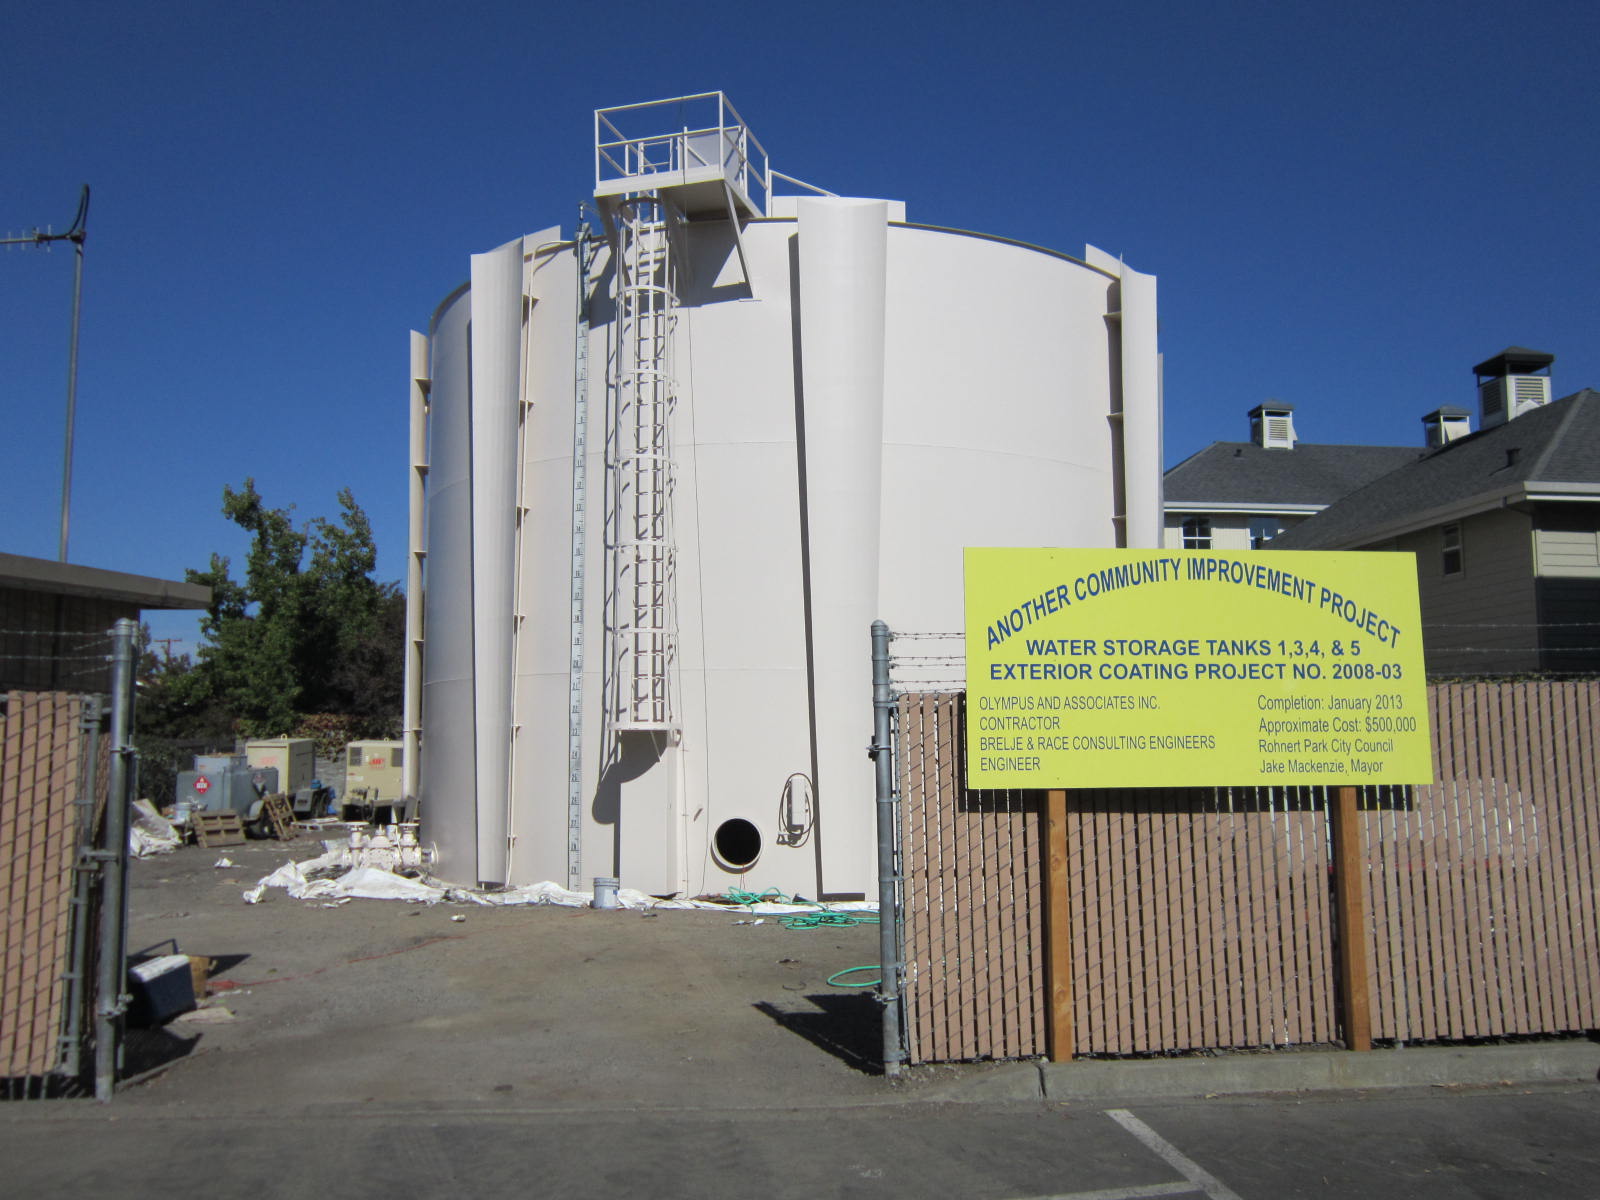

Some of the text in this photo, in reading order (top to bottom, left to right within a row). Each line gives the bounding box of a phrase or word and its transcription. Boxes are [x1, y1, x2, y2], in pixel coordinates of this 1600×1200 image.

[987, 557, 1401, 651] ANOTHER COMMUNITY IMPROVEMENT PROJECT
[1026, 639, 1097, 656] WATER
[1103, 639, 1200, 656] STORAGE
[1206, 640, 1272, 656] TANKS
[1331, 640, 1345, 656] &
[1350, 640, 1361, 656] 5
[990, 663, 1403, 680] EXTERIOR COATING PROJECT NO. 2008-03
[979, 695, 1161, 710] OLYMPUS AND ASSOCIATES INC.
[1257, 694, 1404, 713] Completion: January 2013
[979, 716, 1061, 731] CONTRACTOR
[1259, 716, 1418, 736] Approximate Cost: $500,000
[979, 735, 1217, 751] BRELJE & RACE CONSULTING ENGINEERS
[1258, 738, 1394, 756] Rohnert Park City Council
[980, 756, 1041, 772] ENGINEER
[1259, 758, 1384, 776] Jake Mackenzie, Mayor
